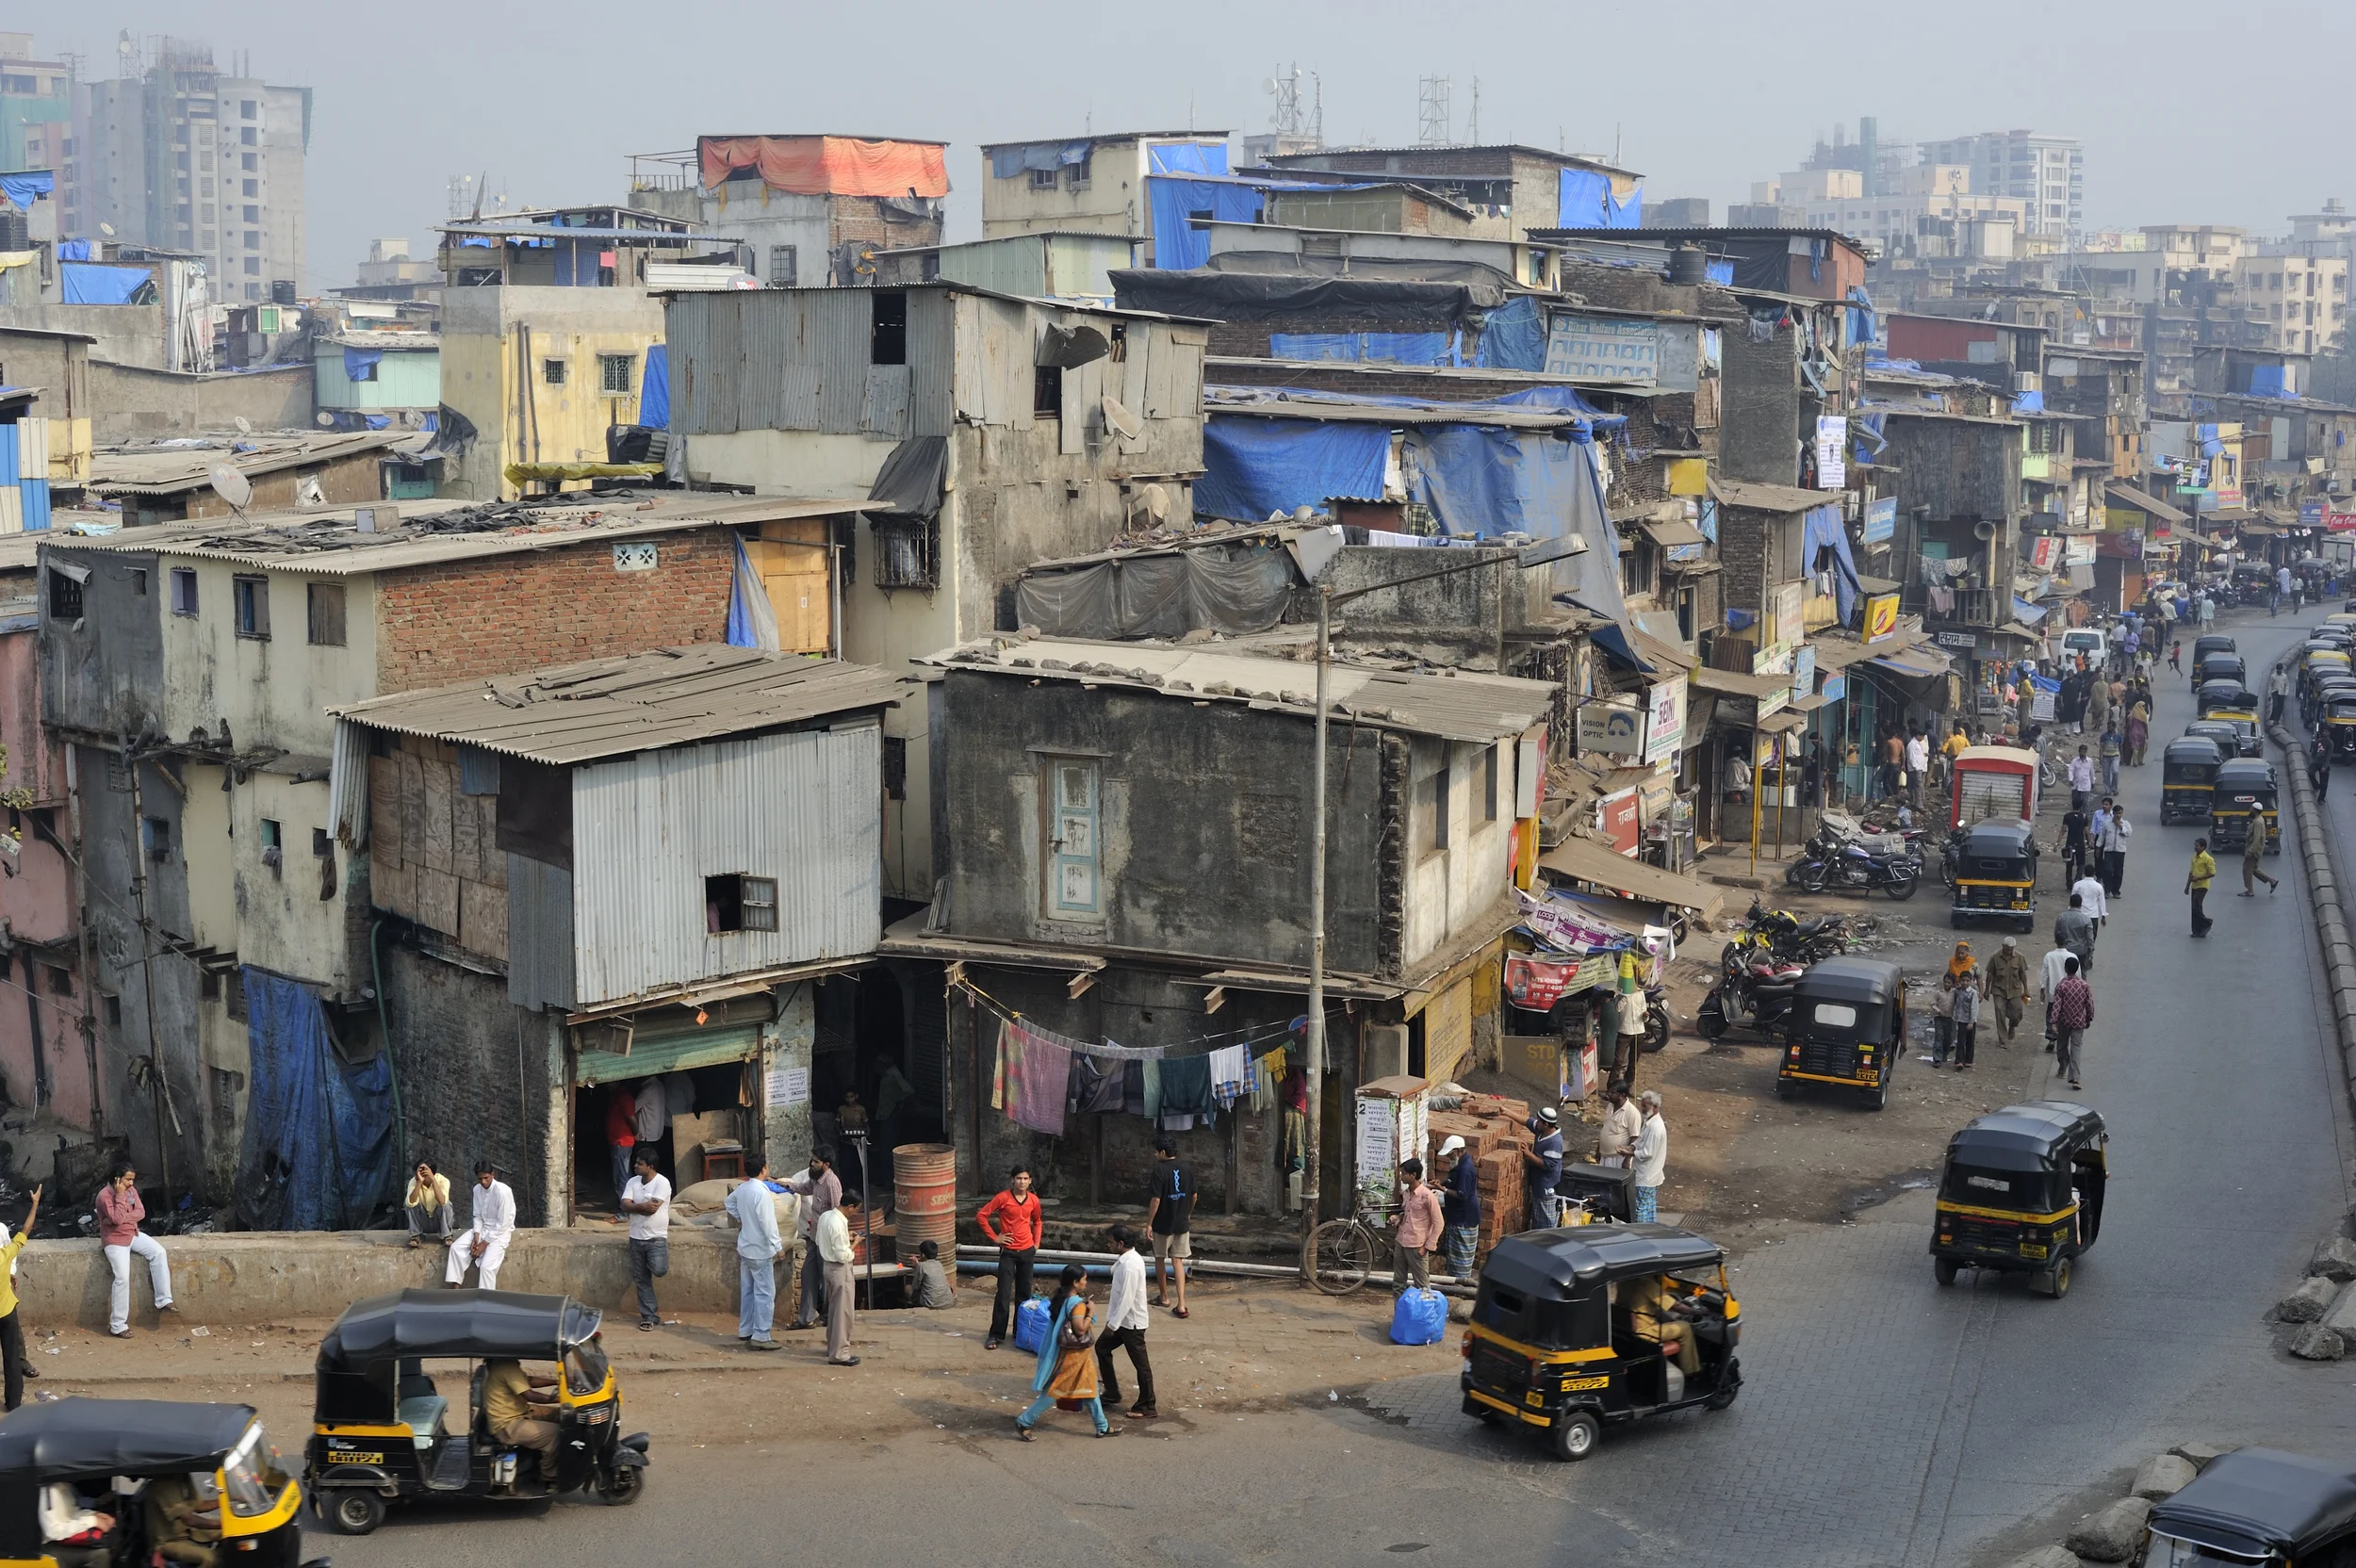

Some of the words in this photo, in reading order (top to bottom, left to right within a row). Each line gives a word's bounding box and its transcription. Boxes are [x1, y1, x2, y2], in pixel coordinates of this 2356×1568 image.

[1567, 320, 1588, 333] Bihar
[1589, 322, 1615, 335] Welfare
[1617, 324, 1657, 336] Association
[1939, 632, 1960, 645] संगम
[1581, 719, 1605, 727] VISION
[1583, 730, 1604, 739] OPTIC
[1617, 801, 1636, 825] राजश्री
[1538, 910, 1555, 921] LOOP
[1527, 1044, 1556, 1059] STD
[1358, 1103, 1366, 1115] 2
